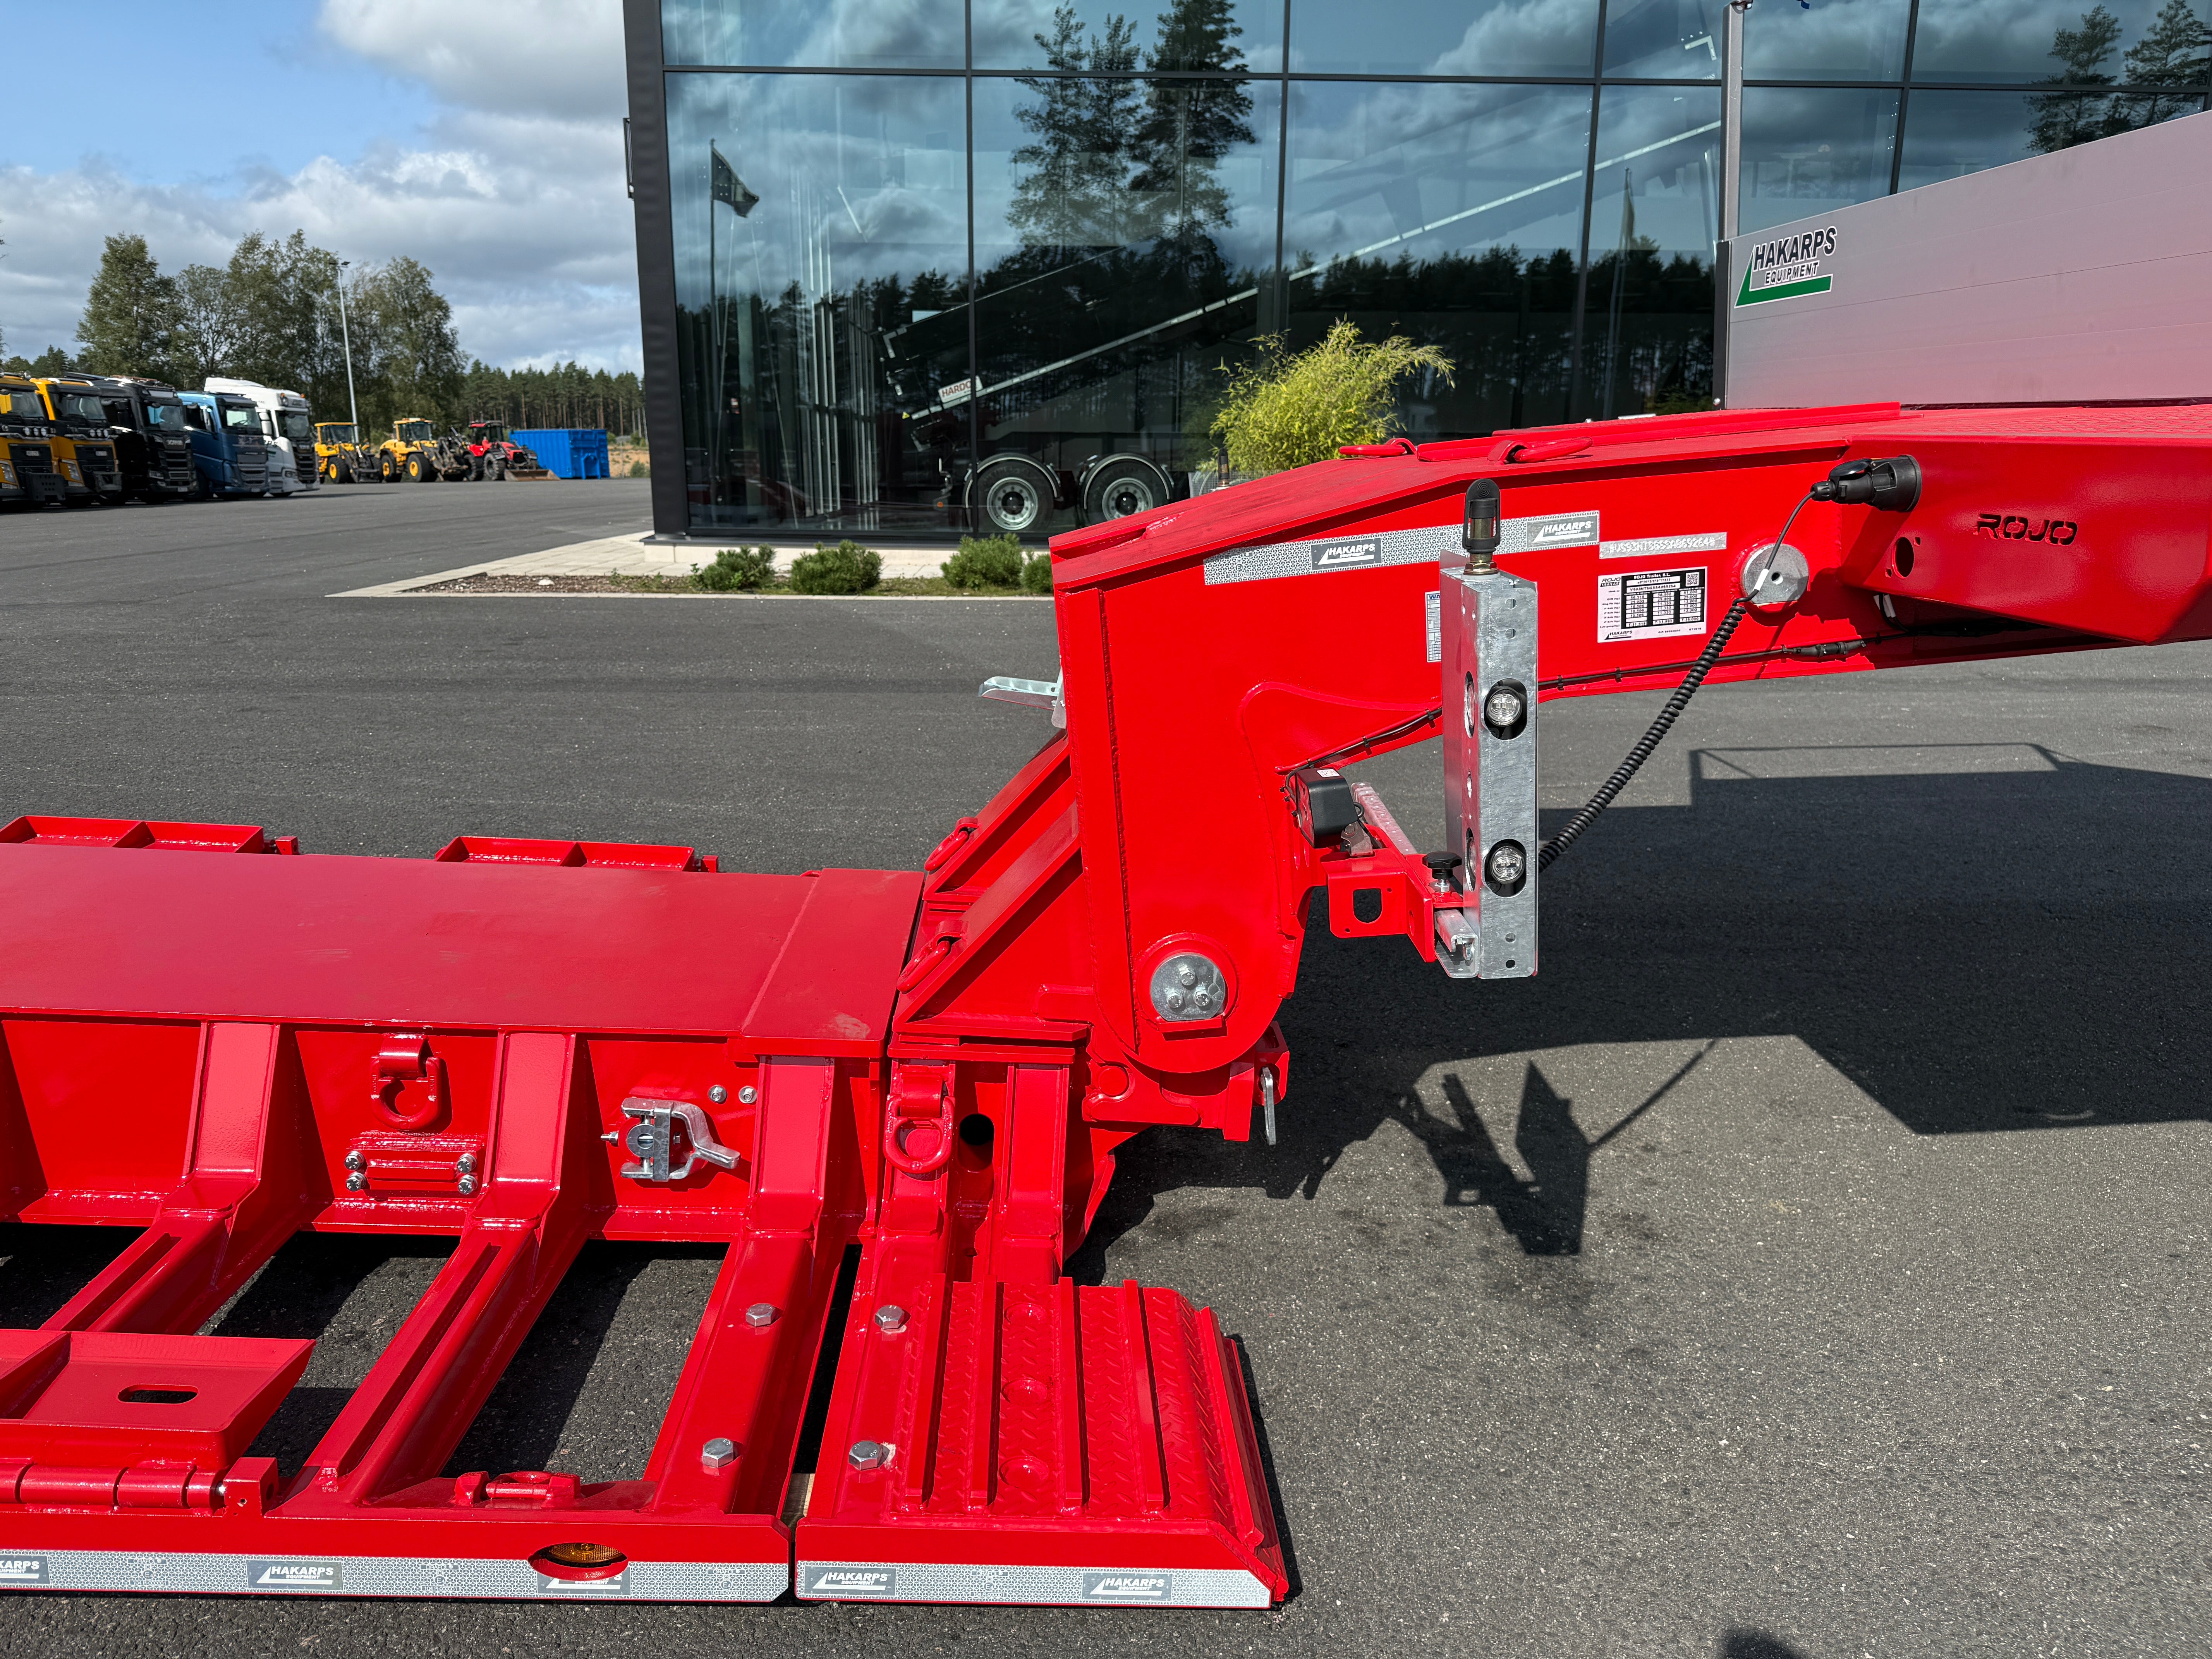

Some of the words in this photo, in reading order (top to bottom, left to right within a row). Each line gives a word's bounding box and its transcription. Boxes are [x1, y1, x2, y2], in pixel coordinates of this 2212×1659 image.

[1753, 227, 1837, 271] HAKARPS
[1765, 262, 1819, 285] EQUIPMENT
[942, 381, 972, 397] HARDO
[1544, 521, 1591, 532] HAKARPS
[1977, 513, 2078, 546] ROJO
[1329, 543, 1375, 555] HAKARPS
[271, 1566, 334, 1576] HAKARPS
[828, 1572, 888, 1582] HAKARPS
[1105, 1578, 1165, 1587] HAKARPS
